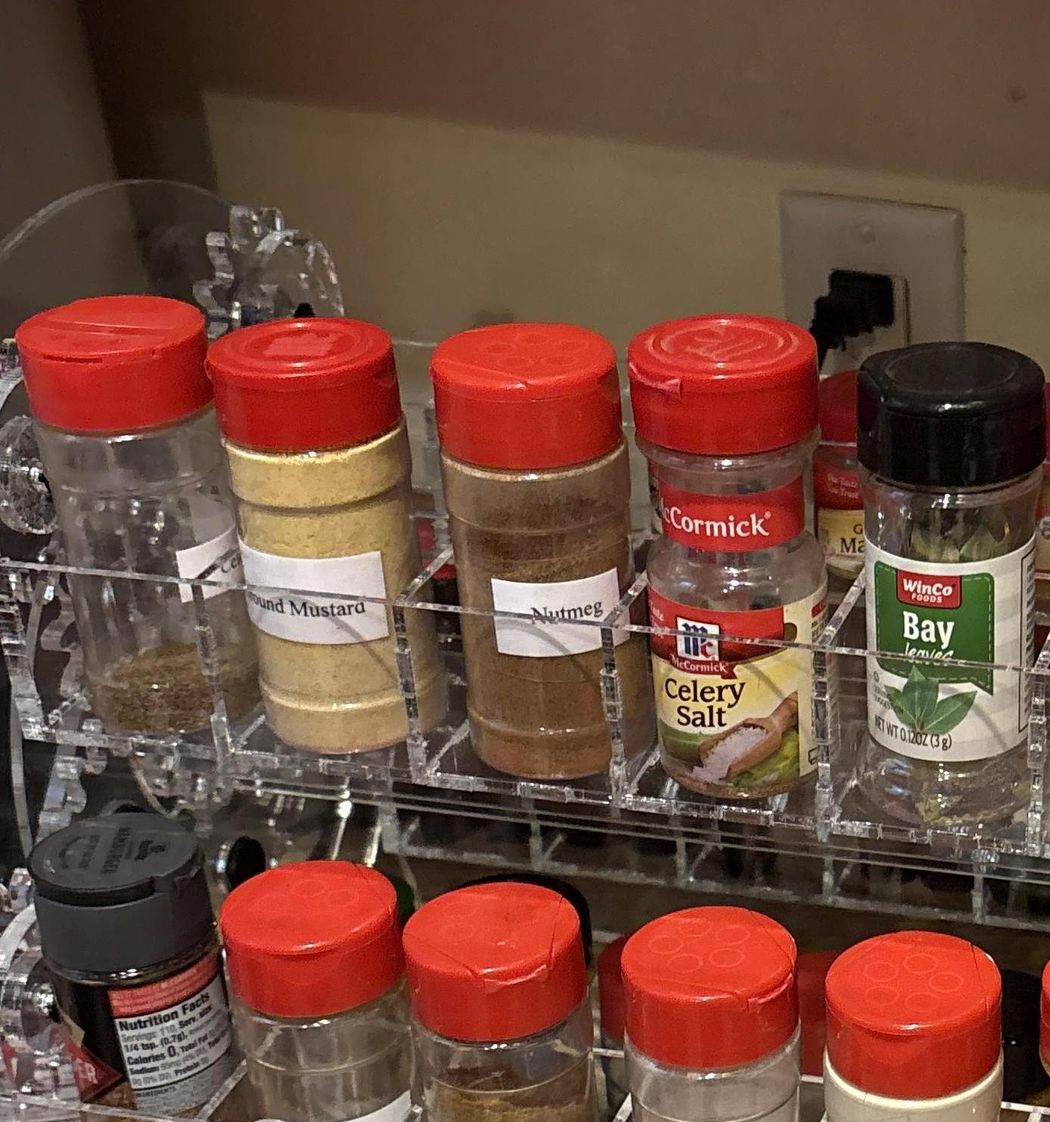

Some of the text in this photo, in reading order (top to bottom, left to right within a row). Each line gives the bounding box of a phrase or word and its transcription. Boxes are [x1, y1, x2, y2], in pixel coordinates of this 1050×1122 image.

[912, 593, 942, 603] FOODS
[290, 600, 366, 618] Mustard
[531, 601, 603, 625] Nutmeg
[903, 611, 954, 649] Bay
[669, 654, 728, 673] McCormick
[665, 678, 746, 708] Celery
[677, 706, 727, 728] Salt
[886, 721, 898, 739] WT
[118, 992, 210, 1031] Nutrition Facts
[127, 1053, 166, 1065] Calories
